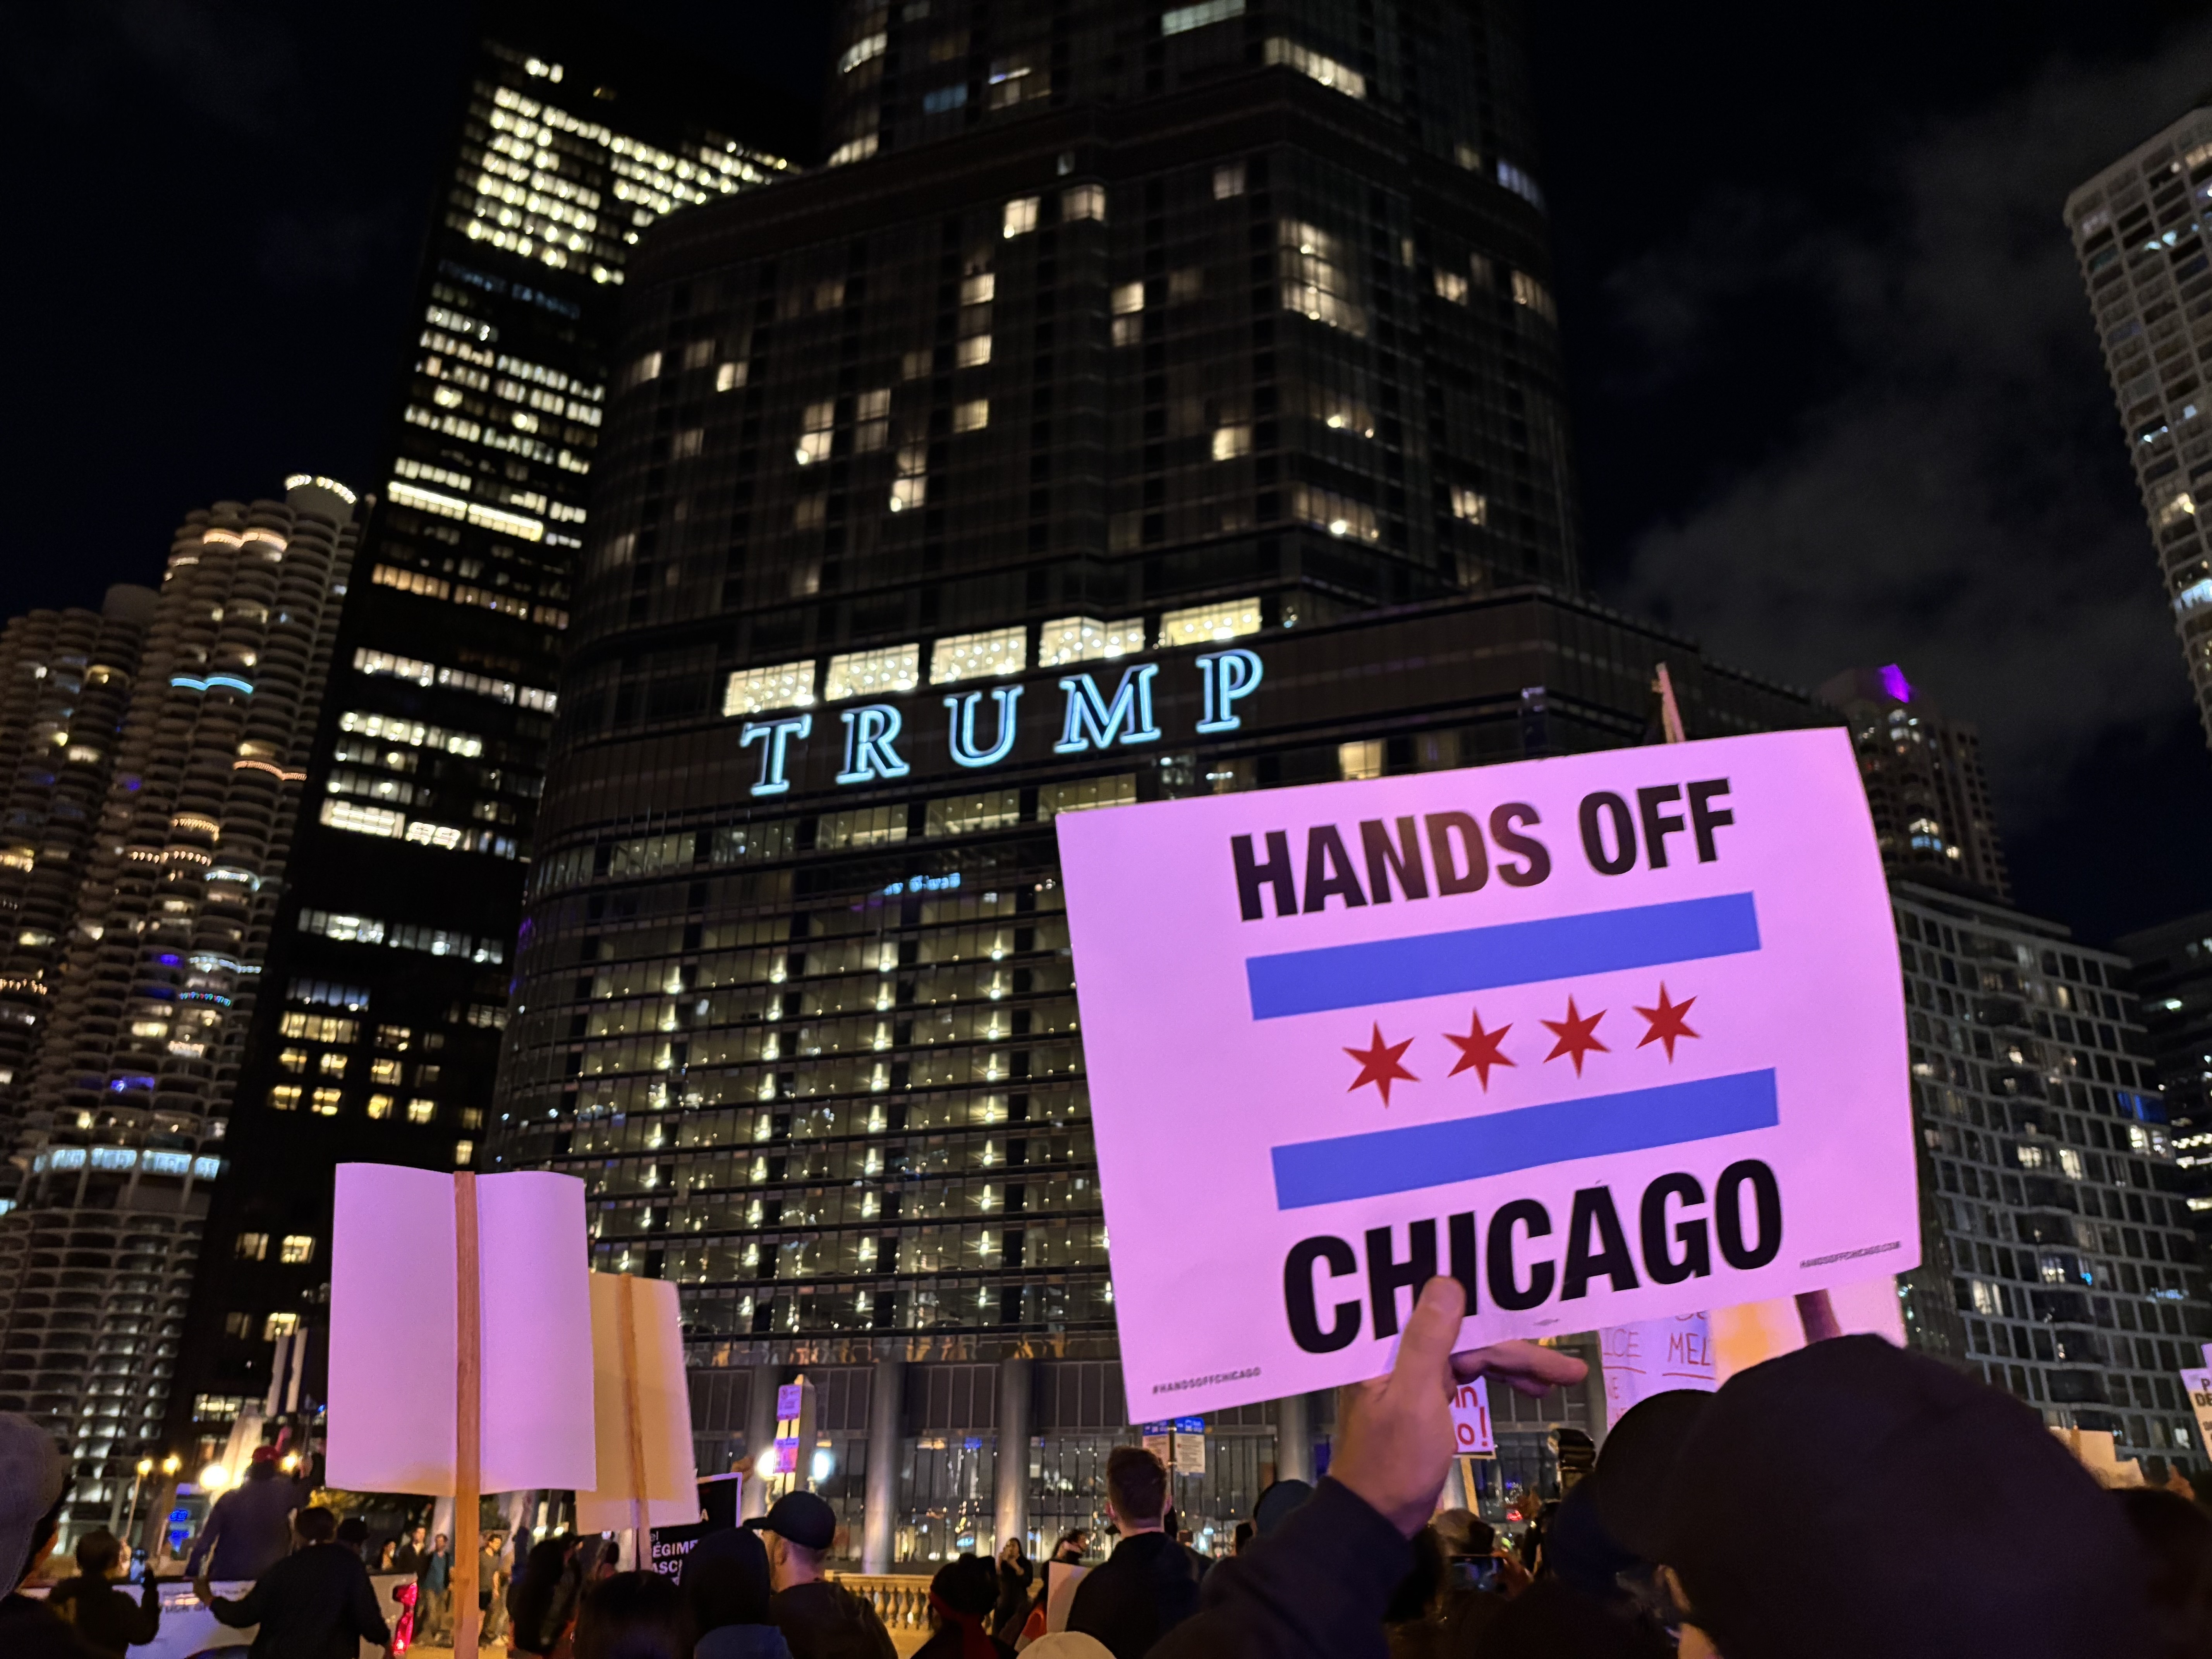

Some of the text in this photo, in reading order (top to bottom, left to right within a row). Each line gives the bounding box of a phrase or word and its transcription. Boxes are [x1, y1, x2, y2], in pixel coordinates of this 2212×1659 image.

[740, 648, 1263, 795] TRUMP
[1231, 777, 1735, 922] HANDS OFF
[1283, 1159, 1782, 1355] CHICAGO
